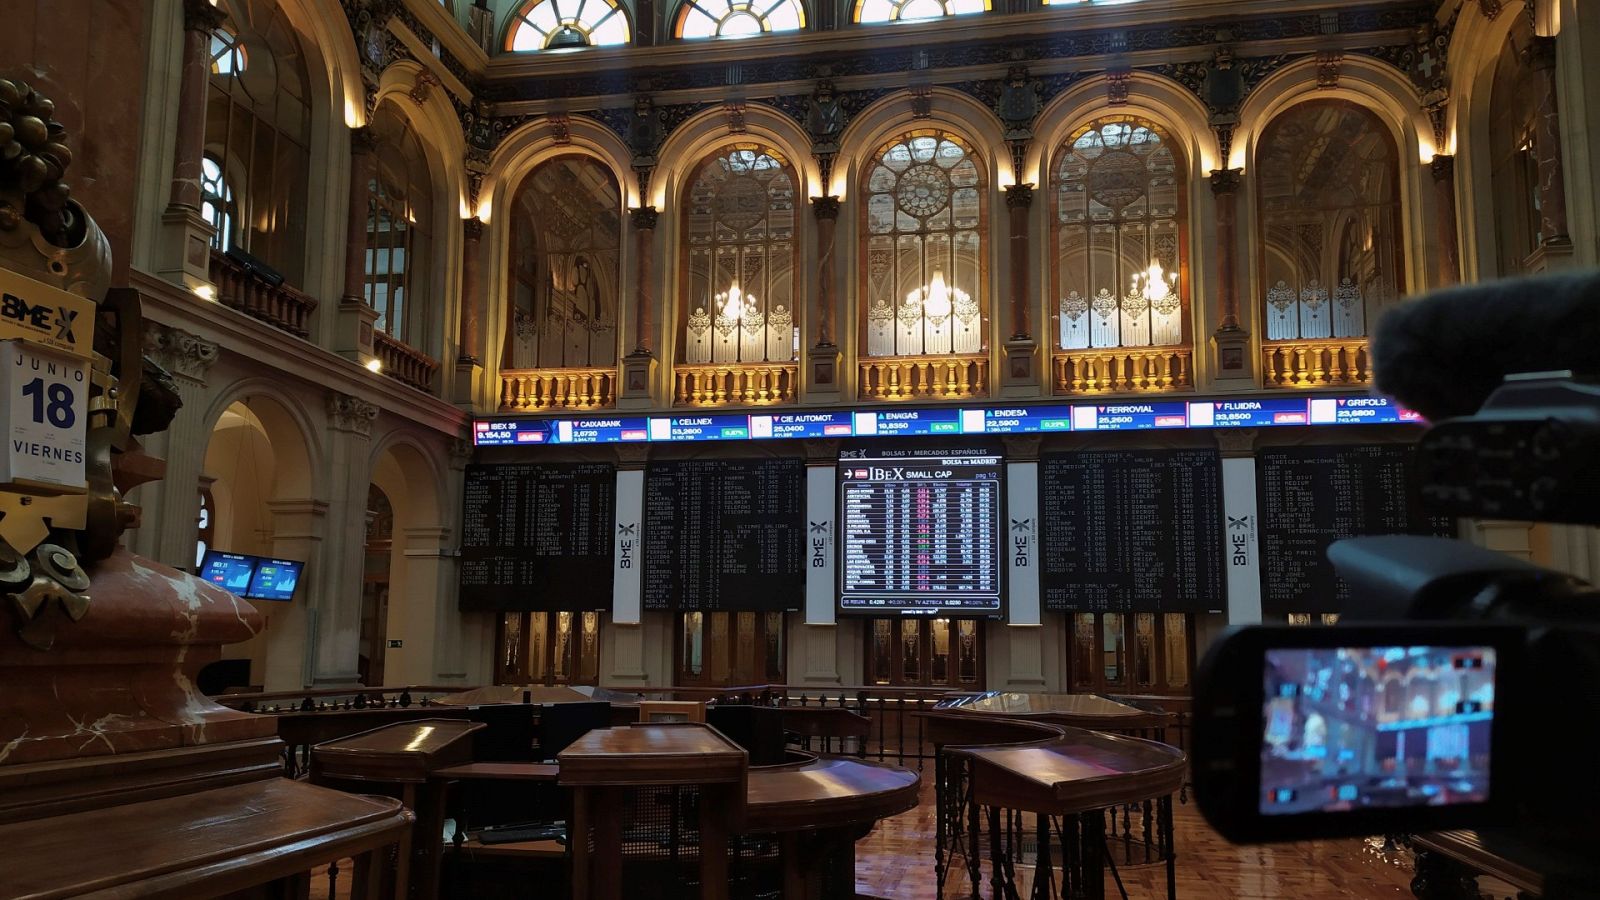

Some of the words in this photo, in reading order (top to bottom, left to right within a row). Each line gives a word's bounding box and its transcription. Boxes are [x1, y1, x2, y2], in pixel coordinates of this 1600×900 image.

[2, 293, 53, 331] BME
[16, 354, 83, 382] JUNIO
[22, 378, 75, 428] 18
[1106, 406, 1153, 414] FERROVIAL
[1348, 398, 1386, 407] GRIFOLS
[580, 420, 621, 428] CAIXABANK
[795, 414, 834, 422] AUTOMOT.
[478, 432, 511, 440] 9.154,50
[14, 440, 82, 464] VIERNES
[869, 467, 904, 480] IBEX
[620, 540, 631, 568] BME
[813, 538, 824, 567] BME
[1015, 536, 1027, 566] BME
[1232, 534, 1246, 566] BME
